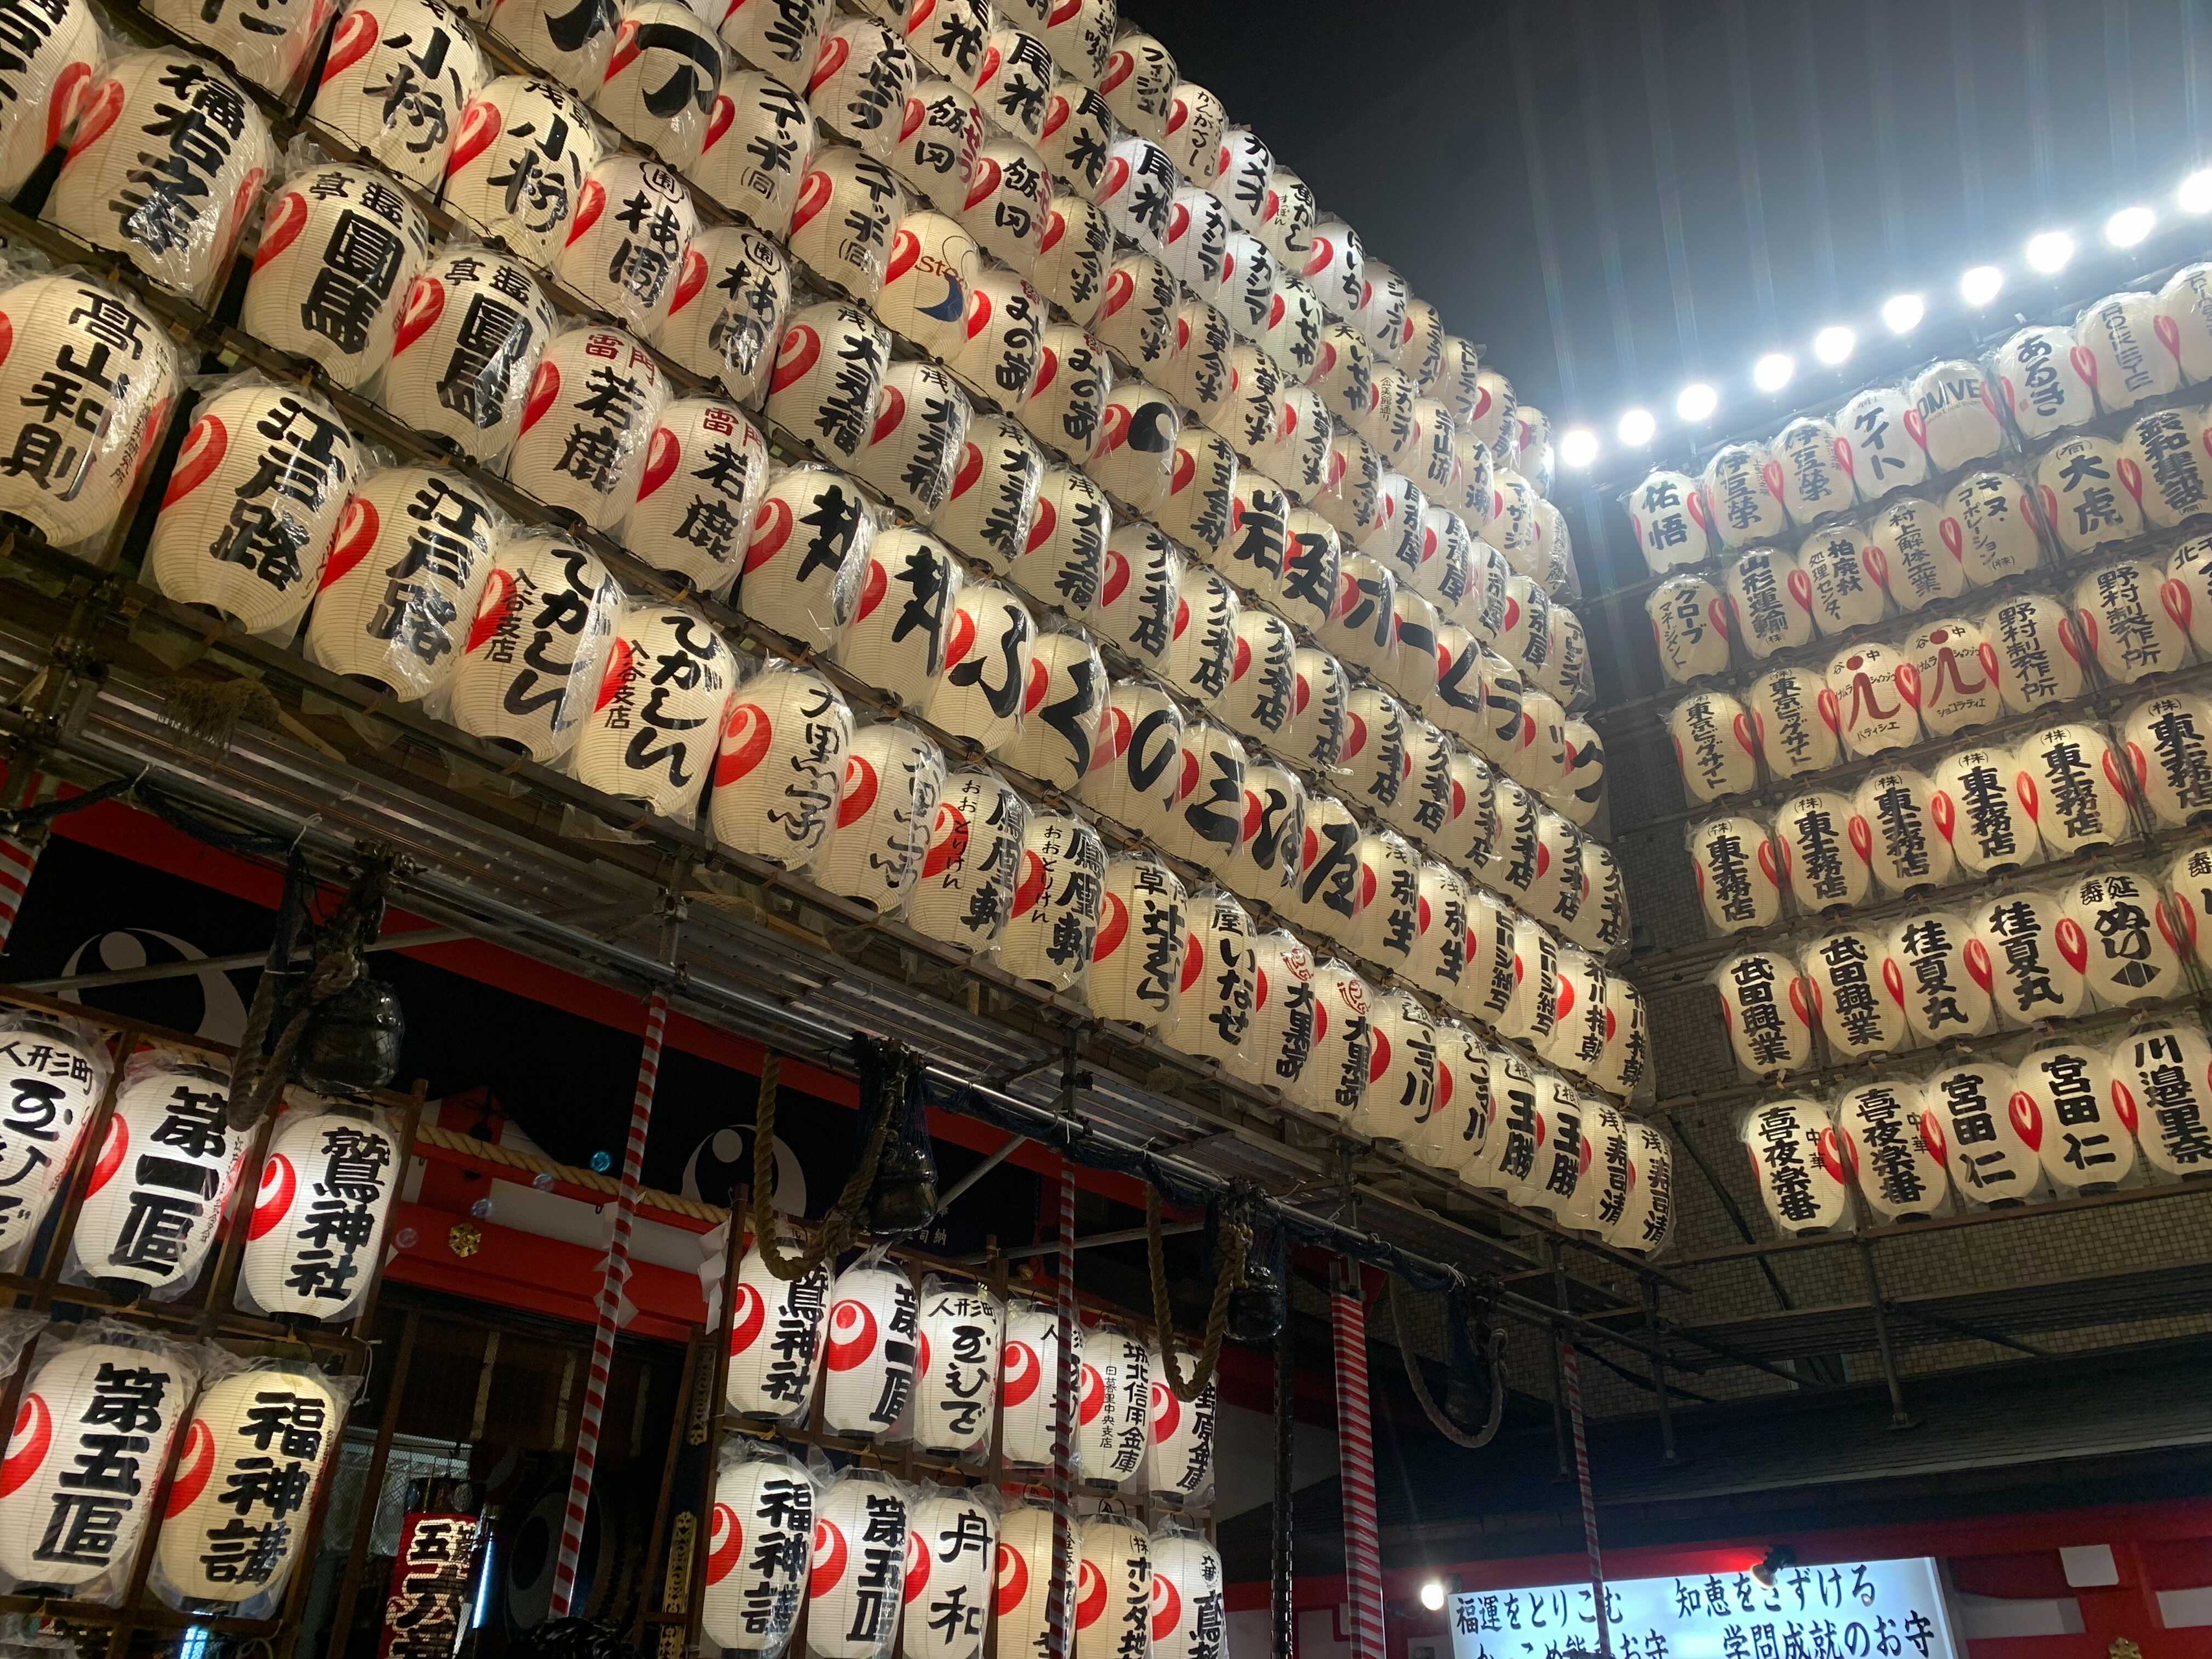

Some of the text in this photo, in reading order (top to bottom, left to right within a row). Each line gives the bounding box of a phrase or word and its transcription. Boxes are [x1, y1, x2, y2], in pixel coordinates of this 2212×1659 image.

[586, 332, 655, 385] 雷門
[1854, 406, 1905, 480] ケイト
[1642, 480, 1687, 550] 祐悟
[1959, 488, 1997, 566] コーポレーション
[2059, 454, 2123, 534] 大虎
[1740, 554, 1788, 638] 山形運輸
[1809, 551, 1841, 620] 処理センター
[1889, 507, 1942, 597] 村上解体工業
[484, 568, 538, 664] 入谷支店
[1659, 601, 1686, 670] マネージメント
[1675, 586, 1706, 645] グローブ
[1998, 603, 2058, 702] 野村製作所
[2098, 566, 2161, 669] 野村製作所
[605, 640, 649, 730] 入谷支店
[1769, 676, 1813, 766] 東京ビッグサイト
[1937, 698, 1986, 717] ショコラティエ
[2148, 699, 2182, 715] (株)
[1686, 701, 1727, 789] 東京ビッグサイト
[1958, 752, 1988, 766] (株)
[2040, 728, 2071, 745] (株)
[2148, 713, 2212, 808] 東工務店
[1795, 796, 1822, 813] (株)
[1874, 774, 1903, 790] (株)
[1958, 767, 2016, 857] 東工務店
[2041, 743, 2102, 838] 東工務店
[942, 780, 981, 890] おおとりけん
[1707, 820, 1732, 835] (株)
[1795, 811, 1847, 899] 東工務店
[1874, 787, 1929, 877] 東工務店
[1032, 826, 1061, 924] おおとりけん
[1707, 835, 1756, 922] 東工務店
[1210, 938, 1254, 1045] いなせ
[1821, 936, 1883, 1046] 武田興業
[1902, 920, 1969, 1030] 桂夏丸
[1990, 901, 2064, 1011] 桂夏丸
[1731, 958, 1791, 1065] 武田興業
[1806, 1128, 1828, 1171] 中華
[1907, 1112, 1931, 1154] 中華
[1941, 1073, 2016, 1189] 宮田仁
[2041, 1054, 2116, 1169] 宮田仁
[285, 1126, 391, 1300] 鷲神社
[1100, 1366, 1117, 1449] 日暮里中央支店
[1110, 1341, 1150, 1473] 城北信用金庫
[199, 1392, 325, 1586] 福神講
[1117, 1557, 1152, 1659] ホンダ地
[1456, 1586, 1624, 1635] 福運をとりこむ
[1724, 1610, 1935, 1659] 学問成就のお守
